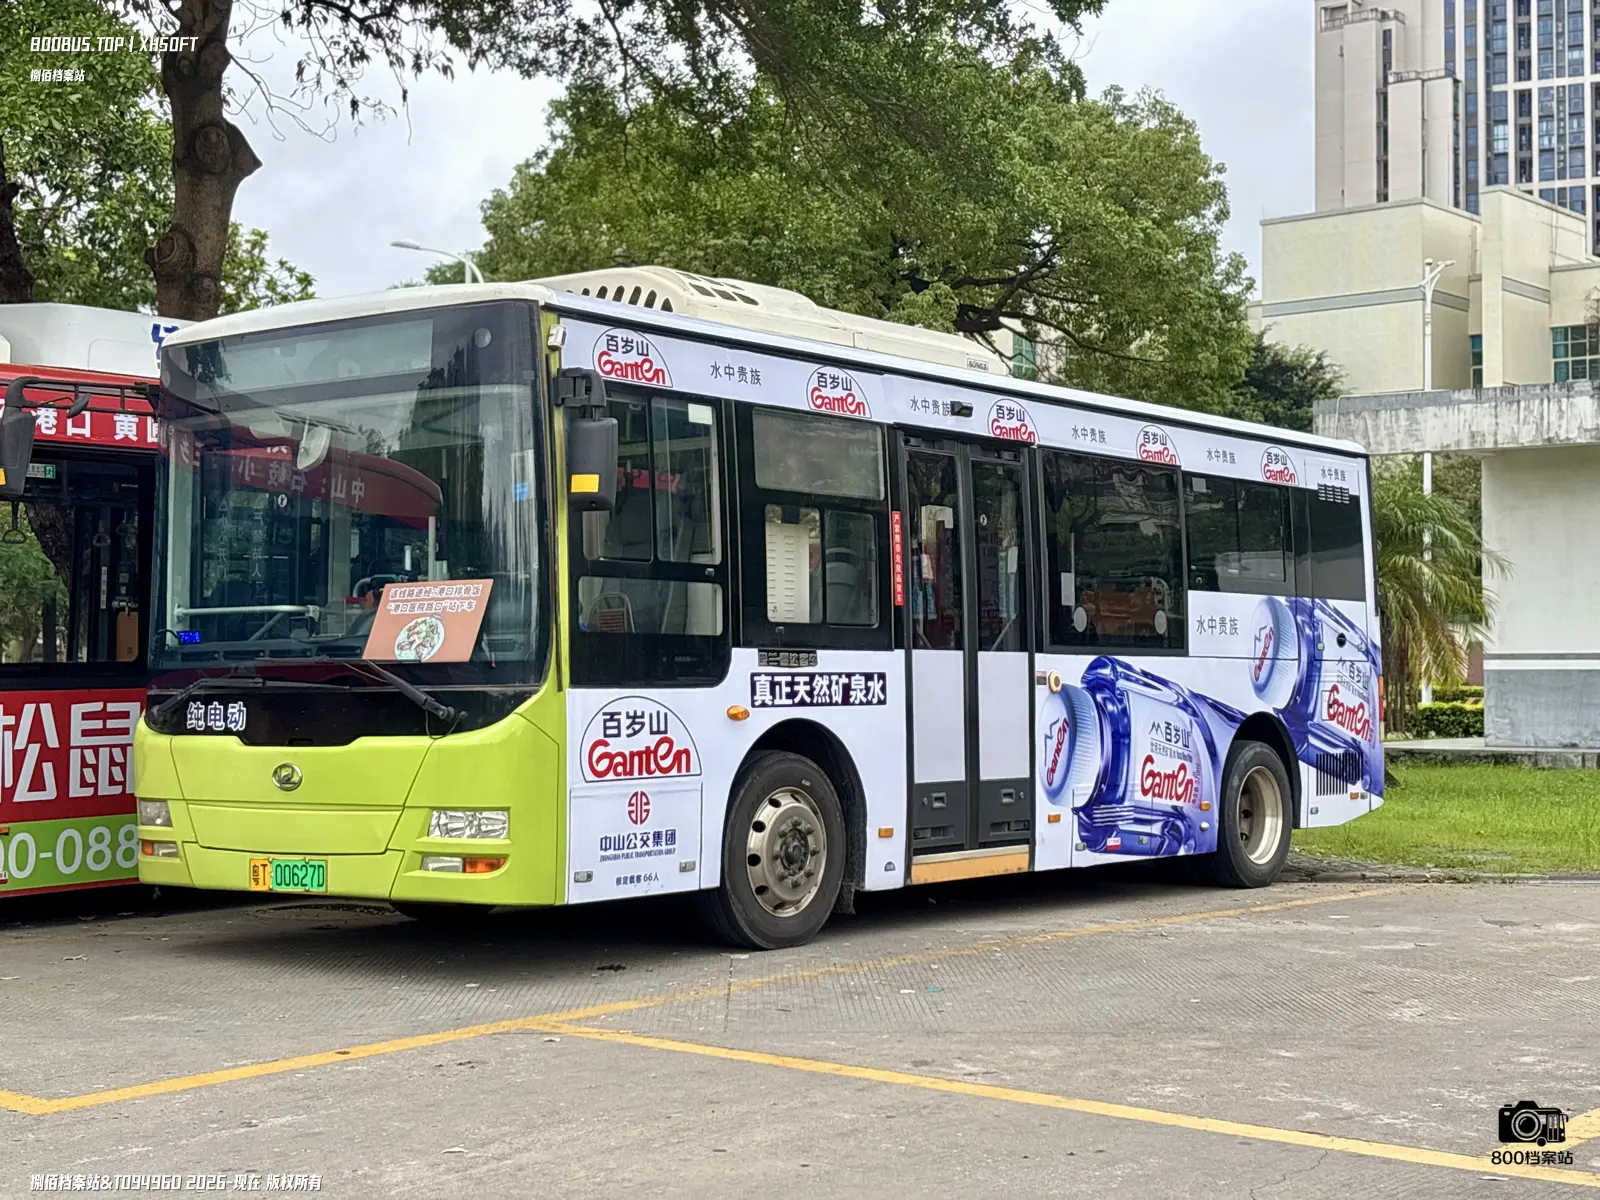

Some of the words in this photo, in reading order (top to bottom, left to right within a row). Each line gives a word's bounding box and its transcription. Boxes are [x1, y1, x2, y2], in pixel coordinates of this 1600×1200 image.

[605, 333, 650, 357] 百岁山
[598, 350, 666, 385] Ganten
[710, 360, 762, 387] 水中贵族
[817, 371, 852, 392] 百岁山
[810, 386, 866, 418] Ganten
[910, 395, 951, 417] 水中贵族
[996, 404, 1026, 423] 百岁山
[30, 401, 91, 438] 港口
[1071, 424, 1107, 445] 水中贵族
[1142, 430, 1168, 446] 百岁山
[1206, 447, 1237, 465] 水中贵族
[1266, 451, 1288, 466] 百岁山
[1320, 467, 1347, 482] 水中贵族
[1196, 616, 1239, 636] 水中贵族
[753, 673, 886, 705] 真正天然矿泉水
[187, 701, 247, 731] 纯电动
[602, 710, 669, 738] 百岁山
[1164, 720, 1191, 749] 百岁山
[0, 702, 141, 802] 松鼠
[588, 736, 691, 779] Ganten
[1140, 754, 1194, 804] Ganten
[0, 824, 139, 879] 0-088
[599, 828, 677, 853] 中山公交集团
